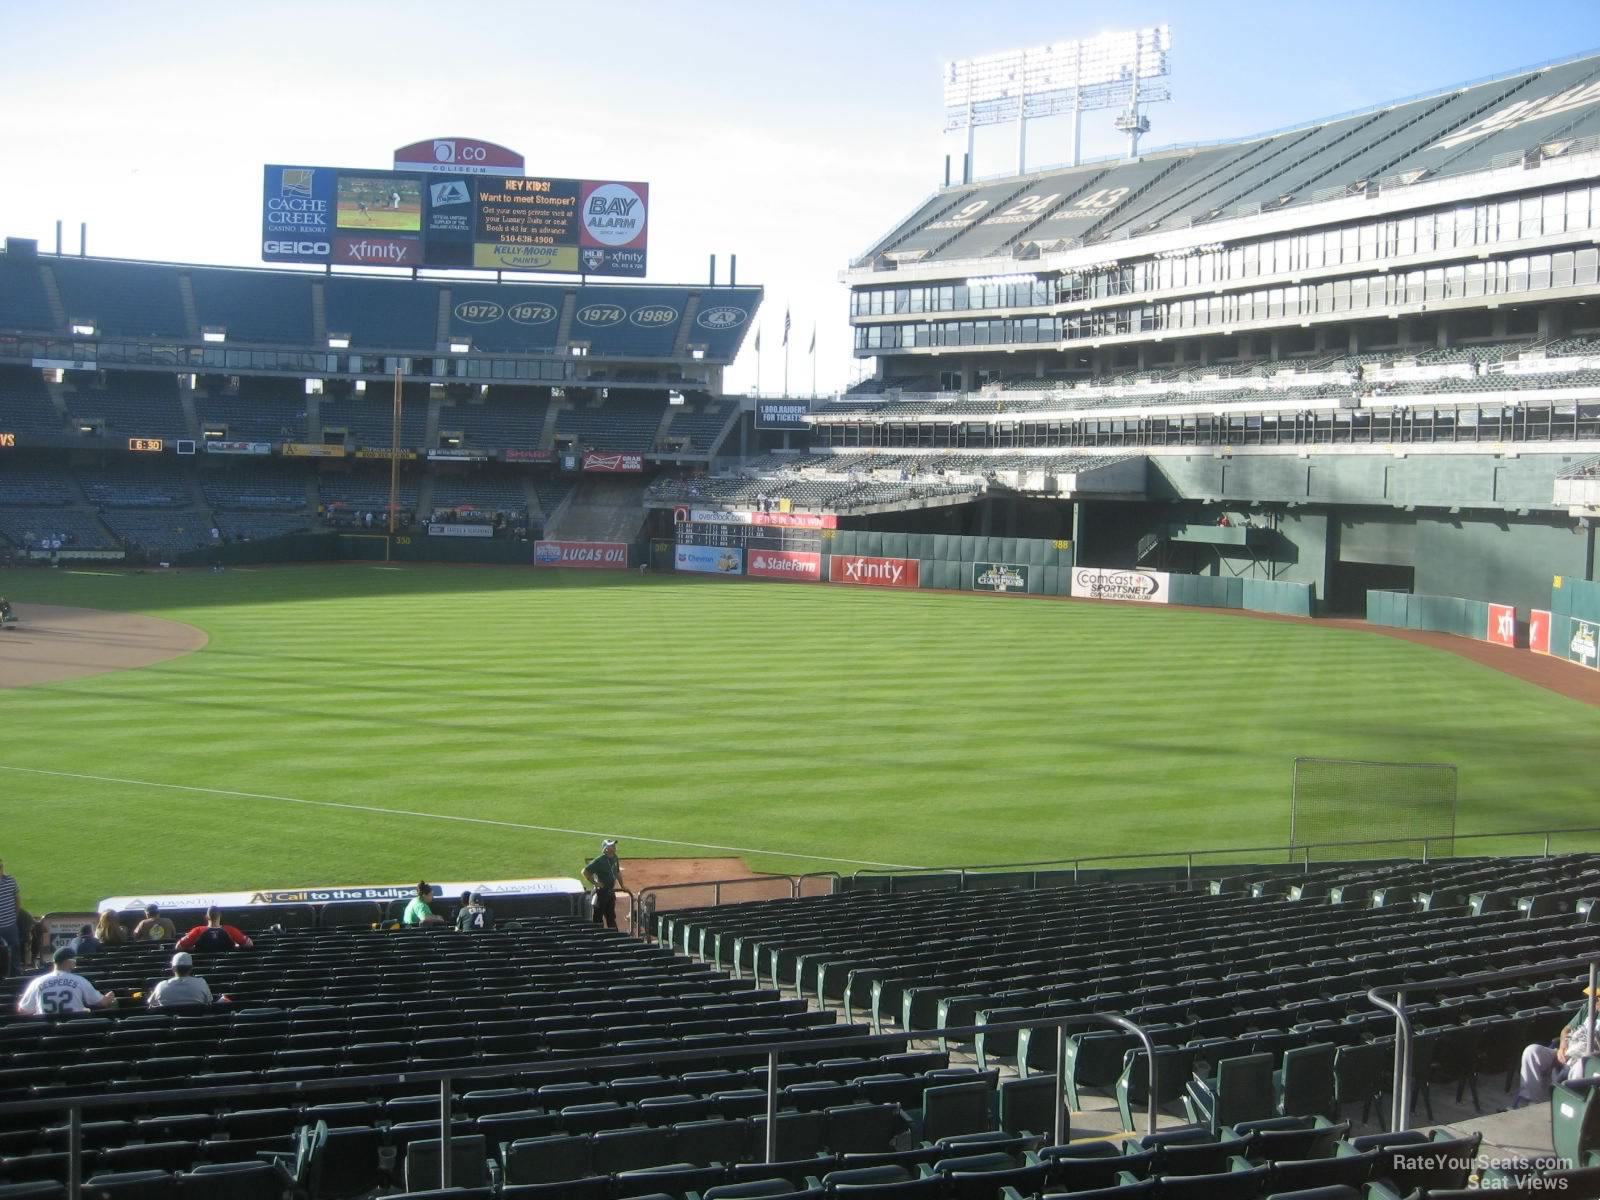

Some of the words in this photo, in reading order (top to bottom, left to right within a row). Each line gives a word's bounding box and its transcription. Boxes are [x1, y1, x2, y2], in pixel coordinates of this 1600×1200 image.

[432, 165, 486, 173] COLISEUM
[505, 180, 523, 191] HEY
[526, 181, 550, 192] KIDS!
[480, 193, 501, 202] Want
[503, 194, 512, 202] to
[536, 195, 575, 206] Stomper?
[1074, 187, 1130, 208] 43
[268, 198, 327, 211] CACHE
[589, 197, 638, 216] BAY
[953, 200, 989, 220] 9
[1001, 193, 1061, 216] 24
[268, 211, 326, 225] CREEK
[588, 217, 636, 228] ALARM
[263, 240, 331, 255] GEICO
[349, 241, 407, 262] xfinity
[612, 252, 644, 263] xfinity
[461, 305, 498, 318] 1972
[514, 306, 551, 319] 1973
[582, 308, 620, 321] 1974
[636, 310, 674, 322] 1989
[0, 434, 15, 447] VS
[136, 441, 160, 450] 6:30
[562, 548, 602, 561] LUCAS
[605, 549, 625, 561] OIL
[688, 554, 714, 563] Chevron
[846, 559, 903, 584] xfinity
[1091, 584, 1148, 595] SPORTSNET
[275, 892, 308, 901] Call
[311, 892, 331, 900] to
[333, 890, 362, 899] the
[365, 888, 418, 898] Bullpe
[473, 913, 484, 928] 4
[43, 990, 73, 1013] 52
